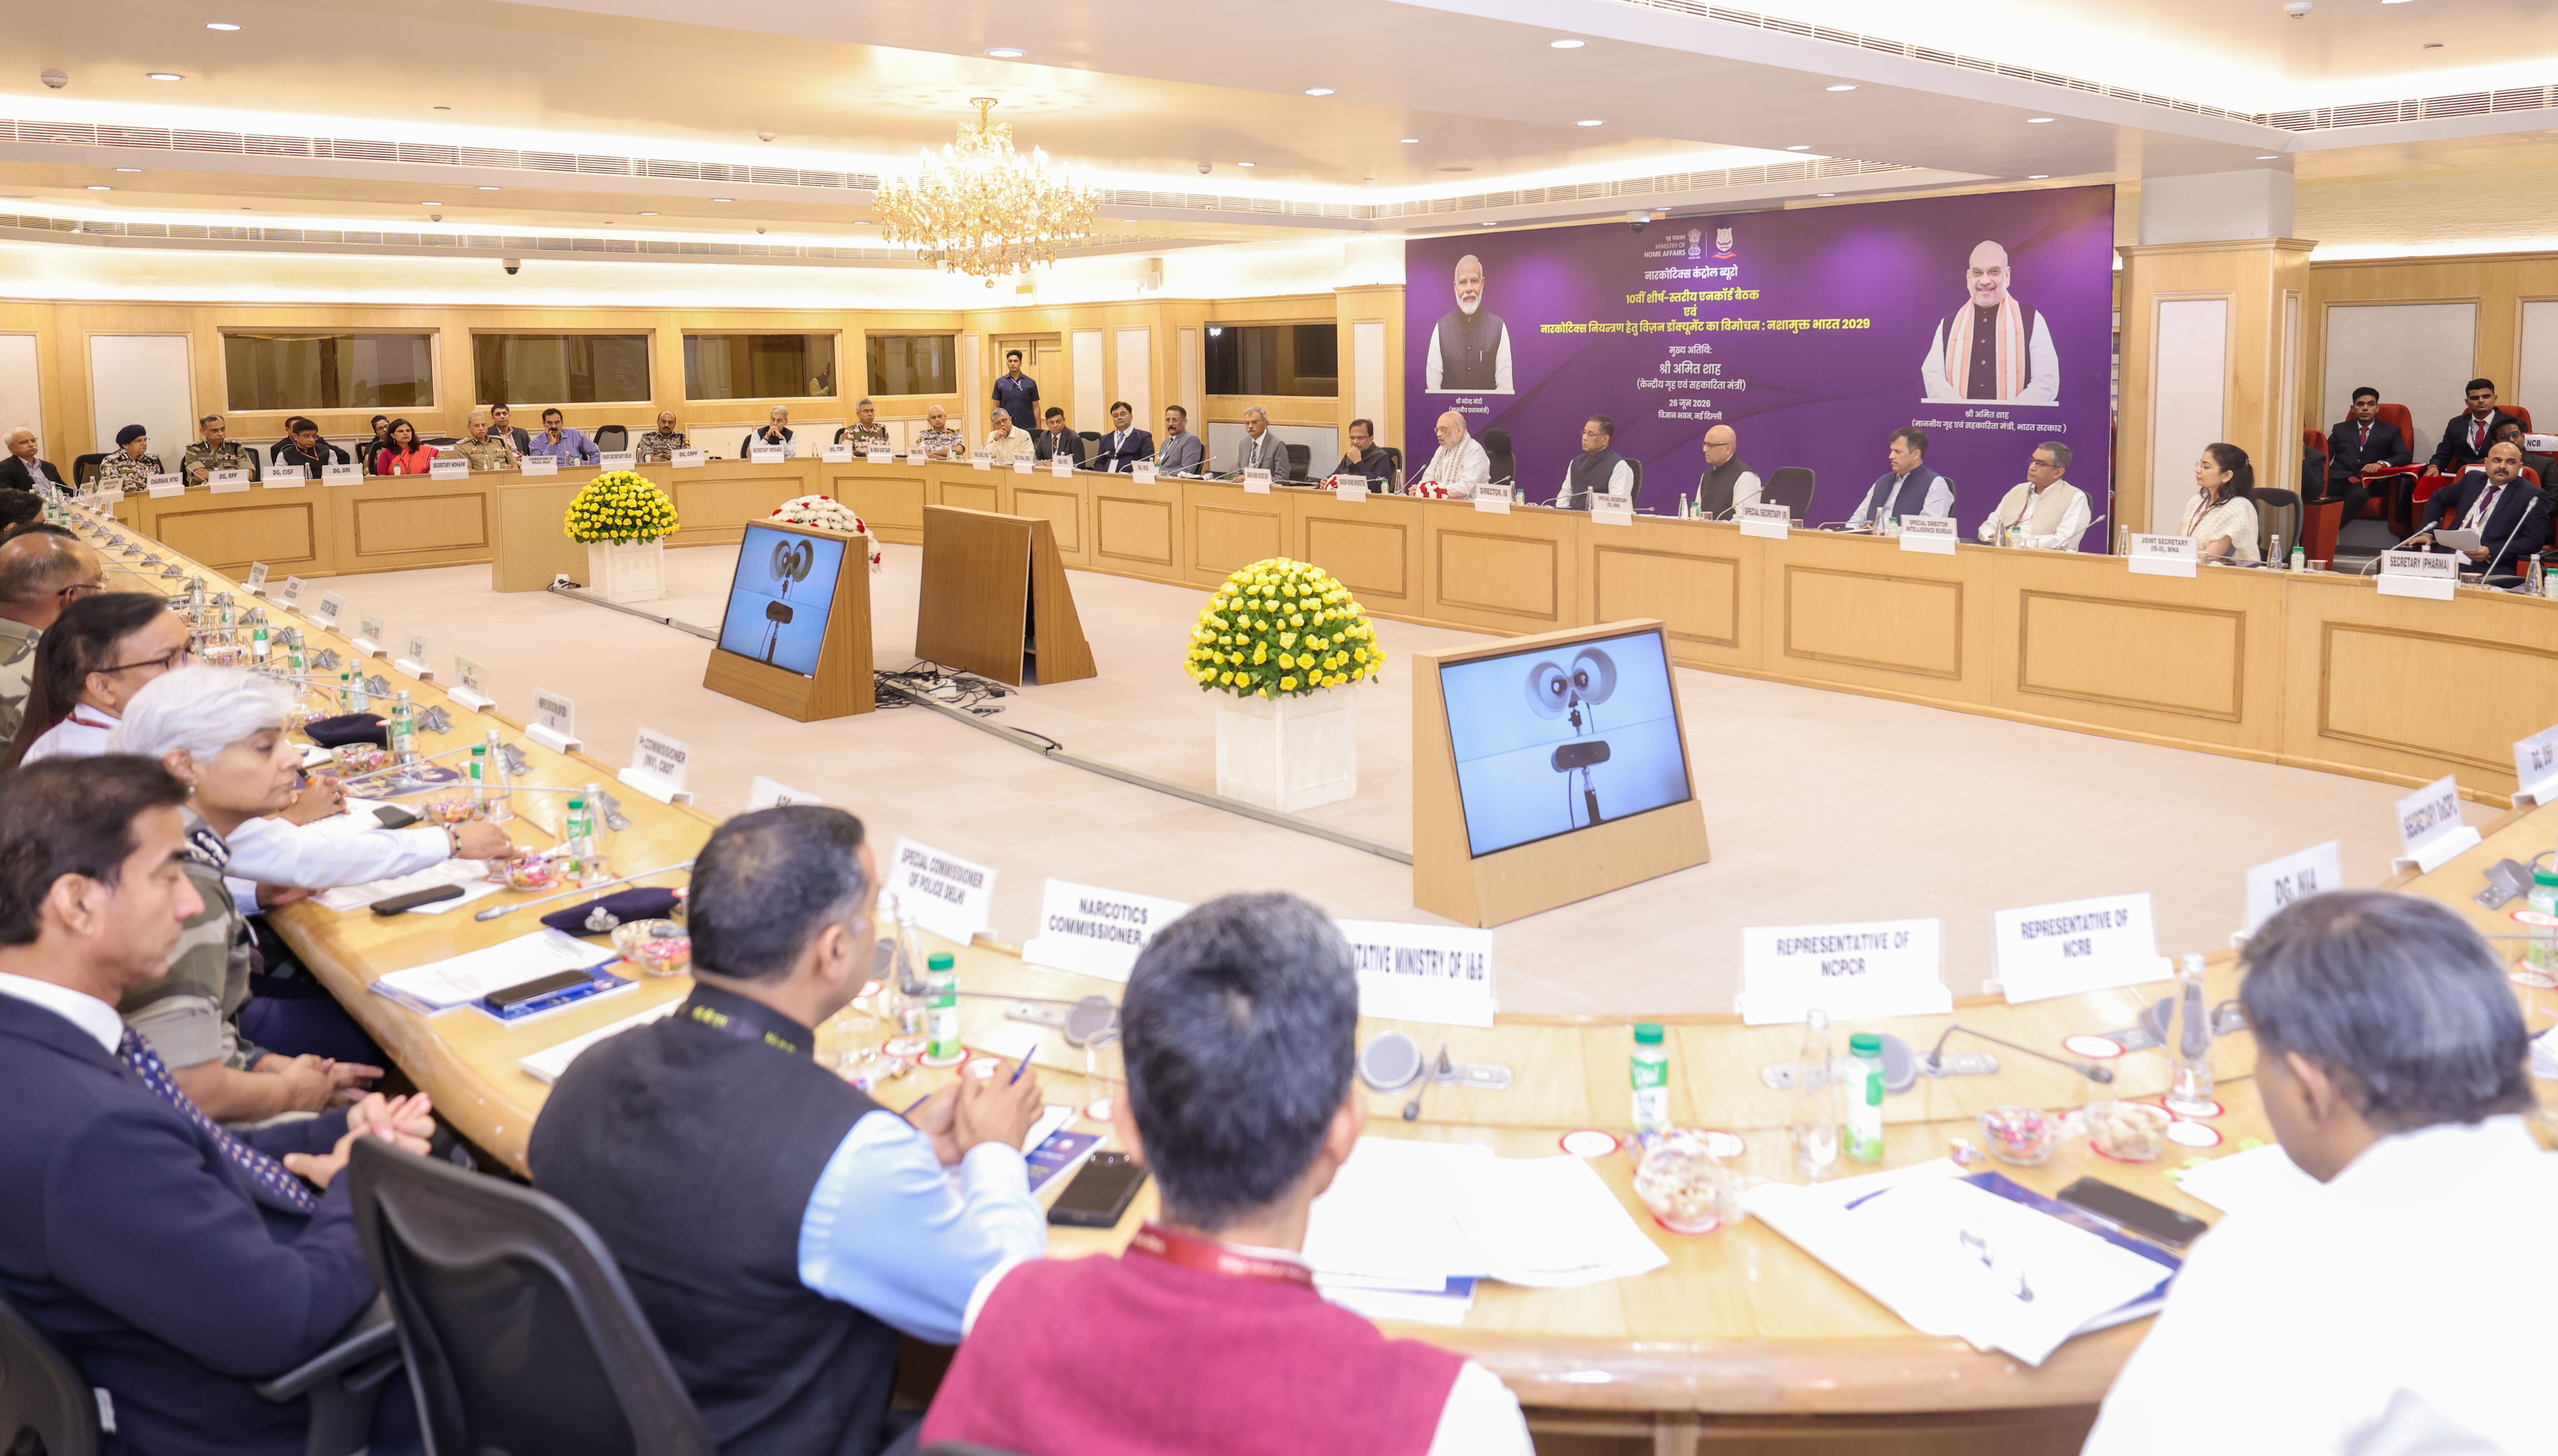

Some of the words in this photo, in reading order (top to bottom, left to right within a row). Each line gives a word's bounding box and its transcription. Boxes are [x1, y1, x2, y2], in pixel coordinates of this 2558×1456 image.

[1644, 267, 1692, 280] नारकोटिक्स
[1692, 265, 1718, 279] कंट्रोल
[1719, 264, 1738, 280] ब्यूरो
[1626, 291, 1645, 304] 10वीं
[1647, 289, 1698, 303] शीर्ष-स्तरीय
[1698, 288, 1735, 301] एनकॉर्ड
[1735, 287, 1760, 300] बैठक
[1683, 304, 1697, 317] एवं
[1540, 321, 1587, 334] नारकोटिक्स
[1588, 320, 1625, 333] नियन्त्रण
[1626, 320, 1639, 336] हेतु
[1667, 319, 1705, 336] डॉक्यूमेंट
[1705, 321, 1720, 332] का
[1721, 318, 1761, 331] विमोचन
[1766, 319, 1811, 334] नशामुक्त
[1813, 319, 1841, 329] भारत
[1842, 318, 1870, 329] 2029
[1669, 346, 1686, 357] मुख्य
[1659, 360, 1671, 374] श्री
[1673, 360, 1701, 374] अमित
[1703, 364, 1722, 376] शाह
[1637, 378, 1664, 389] (केन्द्रीय
[1665, 380, 1676, 391] गृह
[1677, 379, 1688, 389] एवं
[1689, 379, 1726, 390] सहकारिता
[1727, 379, 1746, 392] मंत्री)
[1679, 399, 1692, 410] जून
[1693, 399, 1711, 407] 2026
[1658, 410, 1676, 419] विज्ञान
[1677, 412, 1693, 420] भवन,
[1694, 411, 1704, 420] नई
[1704, 411, 1722, 420] दिल्ली
[1965, 409, 1974, 418] श्री
[1975, 409, 1995, 419] अमित
[1996, 411, 2009, 419] शाह
[1942, 421, 1953, 430] गृह
[1954, 420, 1964, 428] एवं
[1965, 421, 1999, 430] सहकारिता
[1999, 421, 2016, 431] मंत्री,
[1480, 488, 1502, 497] DIRECTOR,
[1745, 507, 1760, 516] SPECIAL
[1760, 509, 1781, 519] SECRETARY
[2390, 556, 2421, 568] SECRETARY
[2422, 557, 2449, 572] (PHARMA)
[900, 847, 928, 871] SPECIAL
[929, 856, 985, 890] COMMISSIONER
[908, 872, 919, 888] OF
[919, 876, 943, 899] POLICE
[943, 883, 966, 906] DELHI
[1079, 897, 1148, 924] NARCOTICS
[1049, 915, 1146, 949] COMMISSIONER,
[2021, 911, 2113, 940] REPRESENTATIVE
[2115, 908, 2129, 928] OF
[1776, 933, 1889, 957] REPRESENTATIVE
[1893, 931, 1910, 948] OF
[2062, 939, 2093, 959] NCRB
[1395, 946, 1445, 977] MINISTRY
[1448, 950, 1462, 979] OF
[1821, 959, 1866, 977] NCPCR
